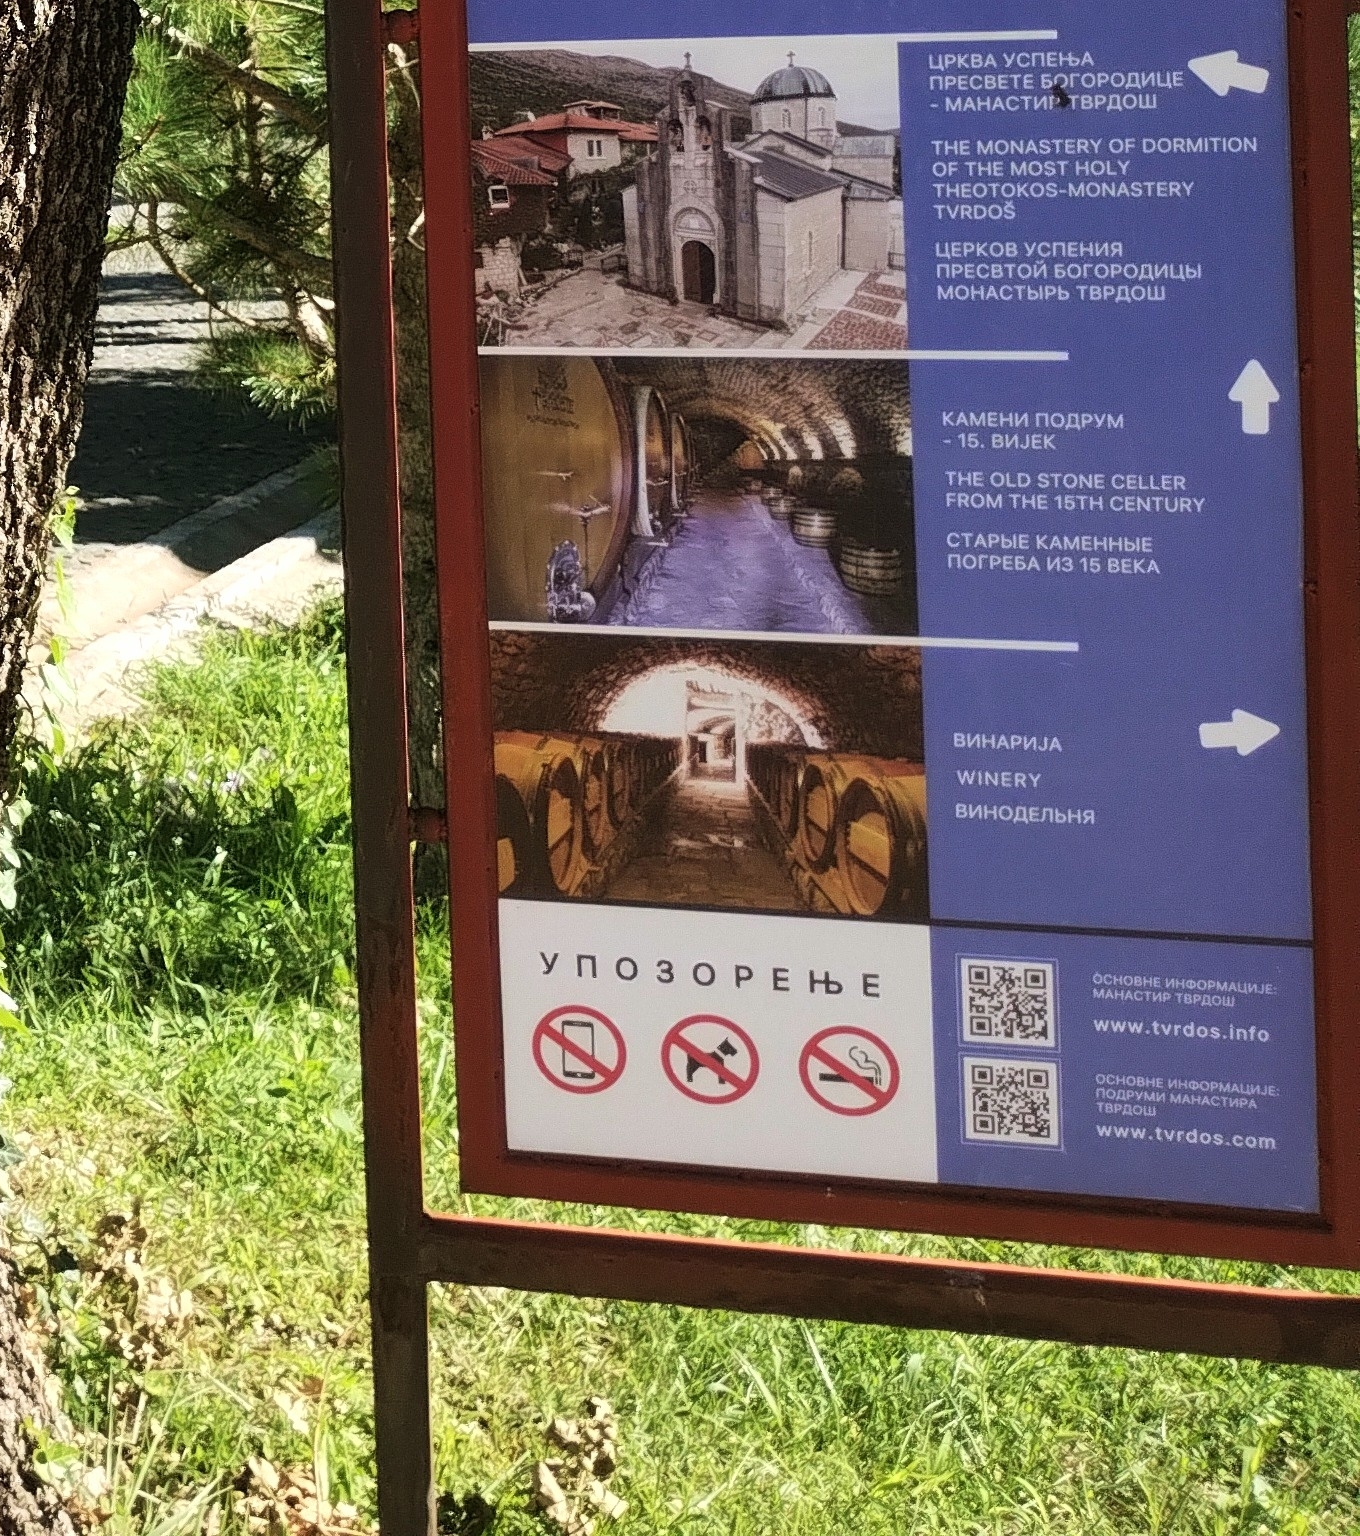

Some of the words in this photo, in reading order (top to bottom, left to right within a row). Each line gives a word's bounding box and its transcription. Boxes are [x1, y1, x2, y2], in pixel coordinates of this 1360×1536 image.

[928, 53, 997, 71] ЦРКВА
[1003, 51, 1095, 69] УСПЕЊА
[929, 74, 1034, 90] ПРЕСВЕТЕ
[1040, 71, 1184, 89] БОГОРОДИЦЕ
[1068, 93, 1158, 112] ТВРДОШ
[931, 139, 970, 156] THE
[976, 138, 1102, 155] MONASTERY
[1109, 138, 1136, 154] OF
[1142, 137, 1257, 154] DORMITION
[932, 161, 958, 177] OF
[965, 161, 1003, 177] THE
[1010, 160, 1069, 177] MOST
[1075, 160, 1131, 176] HOLY
[932, 181, 1194, 199] THEOTOKOS-MONASTERY
[933, 200, 1016, 220] TVRDOŠ
[935, 242, 1018, 260] ЦЕРКОВ
[1023, 241, 1123, 257] УСПЕНИЯ
[936, 260, 1047, 280] ПРЕСВТОЙ
[1054, 263, 1202, 281] БОГОРОДИЦЫ
[937, 284, 1070, 301] МОНАСТЫРЬ
[1075, 284, 1166, 303] ТВРДОШ
[942, 411, 1028, 427] КАМЕНИ
[1035, 413, 1124, 429] ПОДРУМ
[957, 433, 985, 449] 15.
[991, 434, 1056, 450] ВИЈЕК
[945, 471, 983, 487] THE
[990, 472, 1031, 488] OLD
[1037, 473, 1106, 490] STONE
[1111, 474, 1186, 490] CELLER
[945, 492, 1002, 509] FROM
[1009, 493, 1048, 510] THE
[1054, 495, 1103, 511] 15TH
[1109, 496, 1205, 513] CENTURY
[946, 532, 1030, 549] СТАРЫЕ
[1036, 534, 1153, 553] КАМЕННЫЕ
[947, 554, 1041, 572] ПОГРЕБА
[1046, 557, 1074, 572] ИЗ
[1079, 557, 1101, 573] 15
[1107, 558, 1161, 575] ВЕКА
[953, 732, 1062, 752] ВИНАРИЈА
[956, 770, 1042, 788] WINERY
[955, 803, 1095, 824] ВИНОДЕЛЬНЯ
[1092, 972, 1161, 987] ОСНОВНЕ
[1092, 988, 1171, 1002] МАНАСТИР
[1175, 993, 1235, 1007] ТВРДОШ
[1093, 1019, 1270, 1042] www.tvrdos.info
[1095, 1074, 1164, 1088] ОСНОВНЕ
[1095, 1088, 1166, 1103] ПОДРУМИ
[1169, 1093, 1258, 1109] МАНАСТИРА
[1097, 1102, 1156, 1117] ТВРДОШ
[1096, 1124, 1276, 1150] www.tvrdos.com
